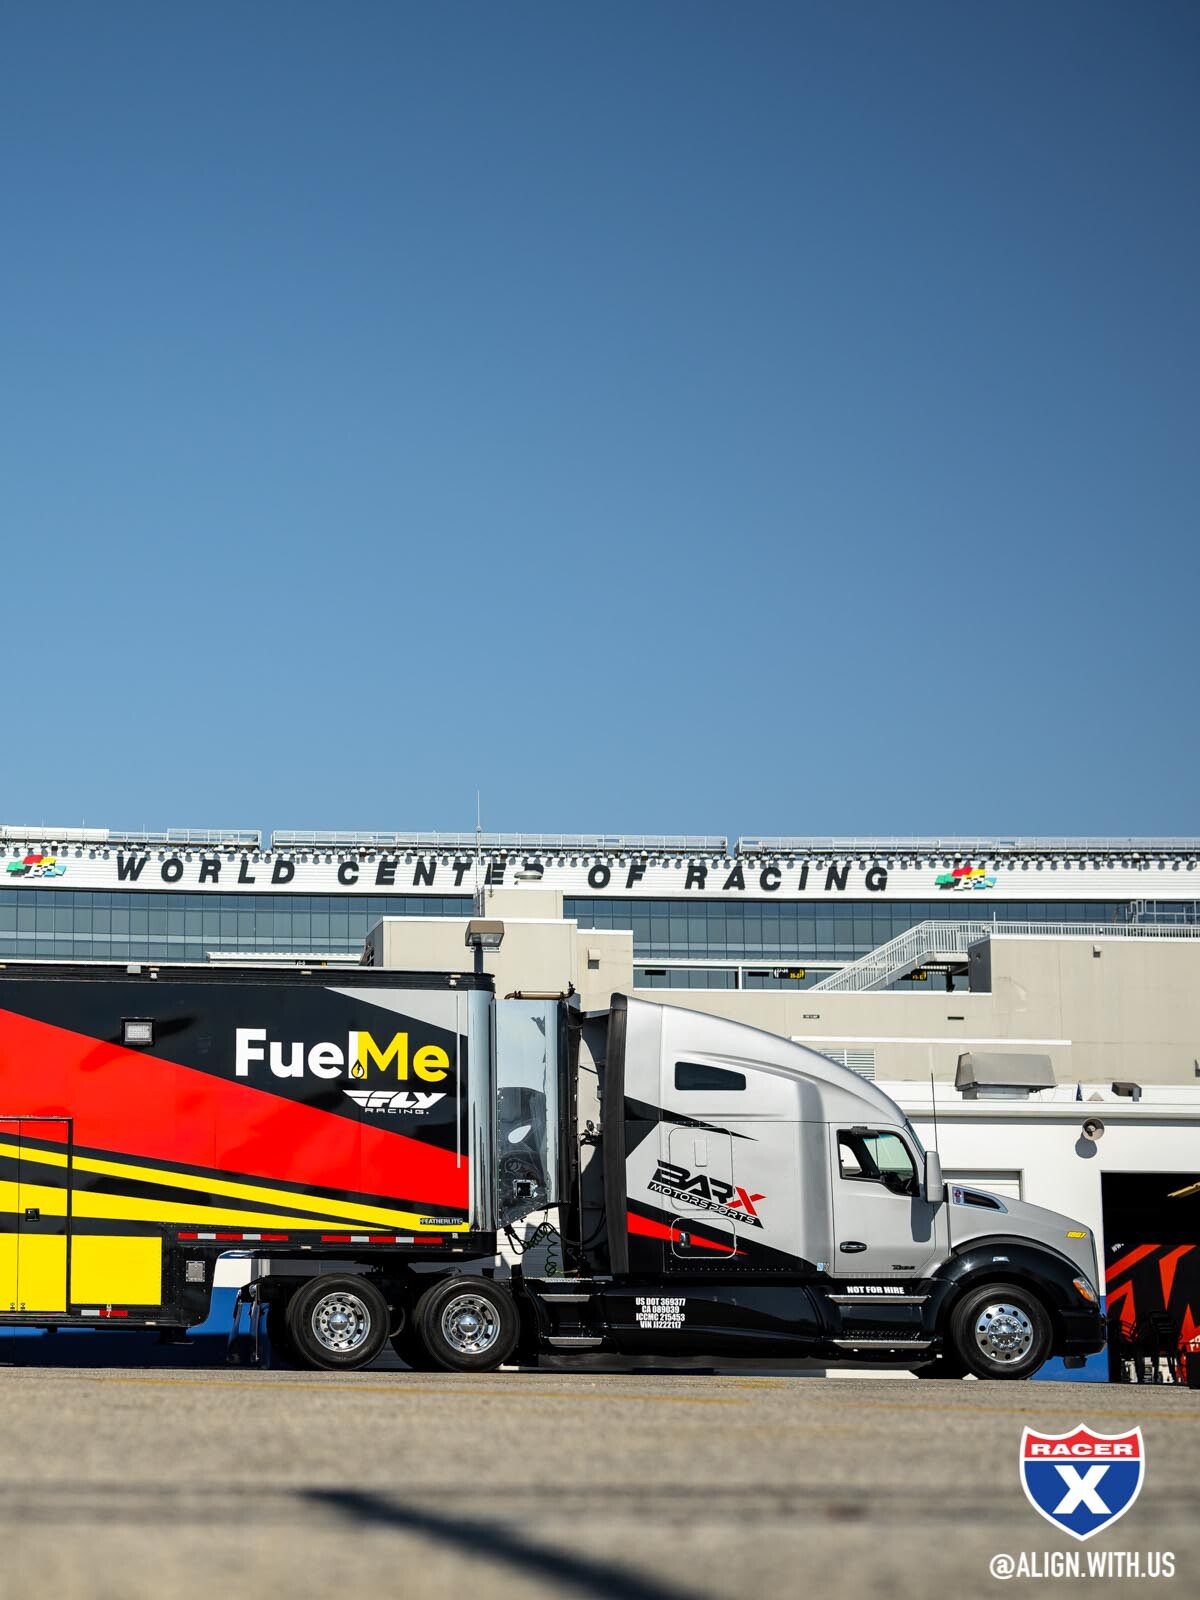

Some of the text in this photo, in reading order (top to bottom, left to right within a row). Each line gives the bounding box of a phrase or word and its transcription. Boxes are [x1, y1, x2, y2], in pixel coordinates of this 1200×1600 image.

[117, 857, 295, 885] WORLD
[587, 864, 647, 889] OF
[685, 865, 888, 892] RACING
[235, 1027, 450, 1083] FuelMe
[342, 1089, 447, 1109] FLY
[652, 1159, 767, 1217] BARX
[650, 1183, 755, 1224] MOTORSPORTS
[846, 1286, 905, 1295] NOT FOR HIRE
[635, 1297, 686, 1307] US DOT 369377
[641, 1305, 651, 1313] CA
[640, 1320, 652, 1328] VIN
[659, 1313, 686, 1322] 215453
